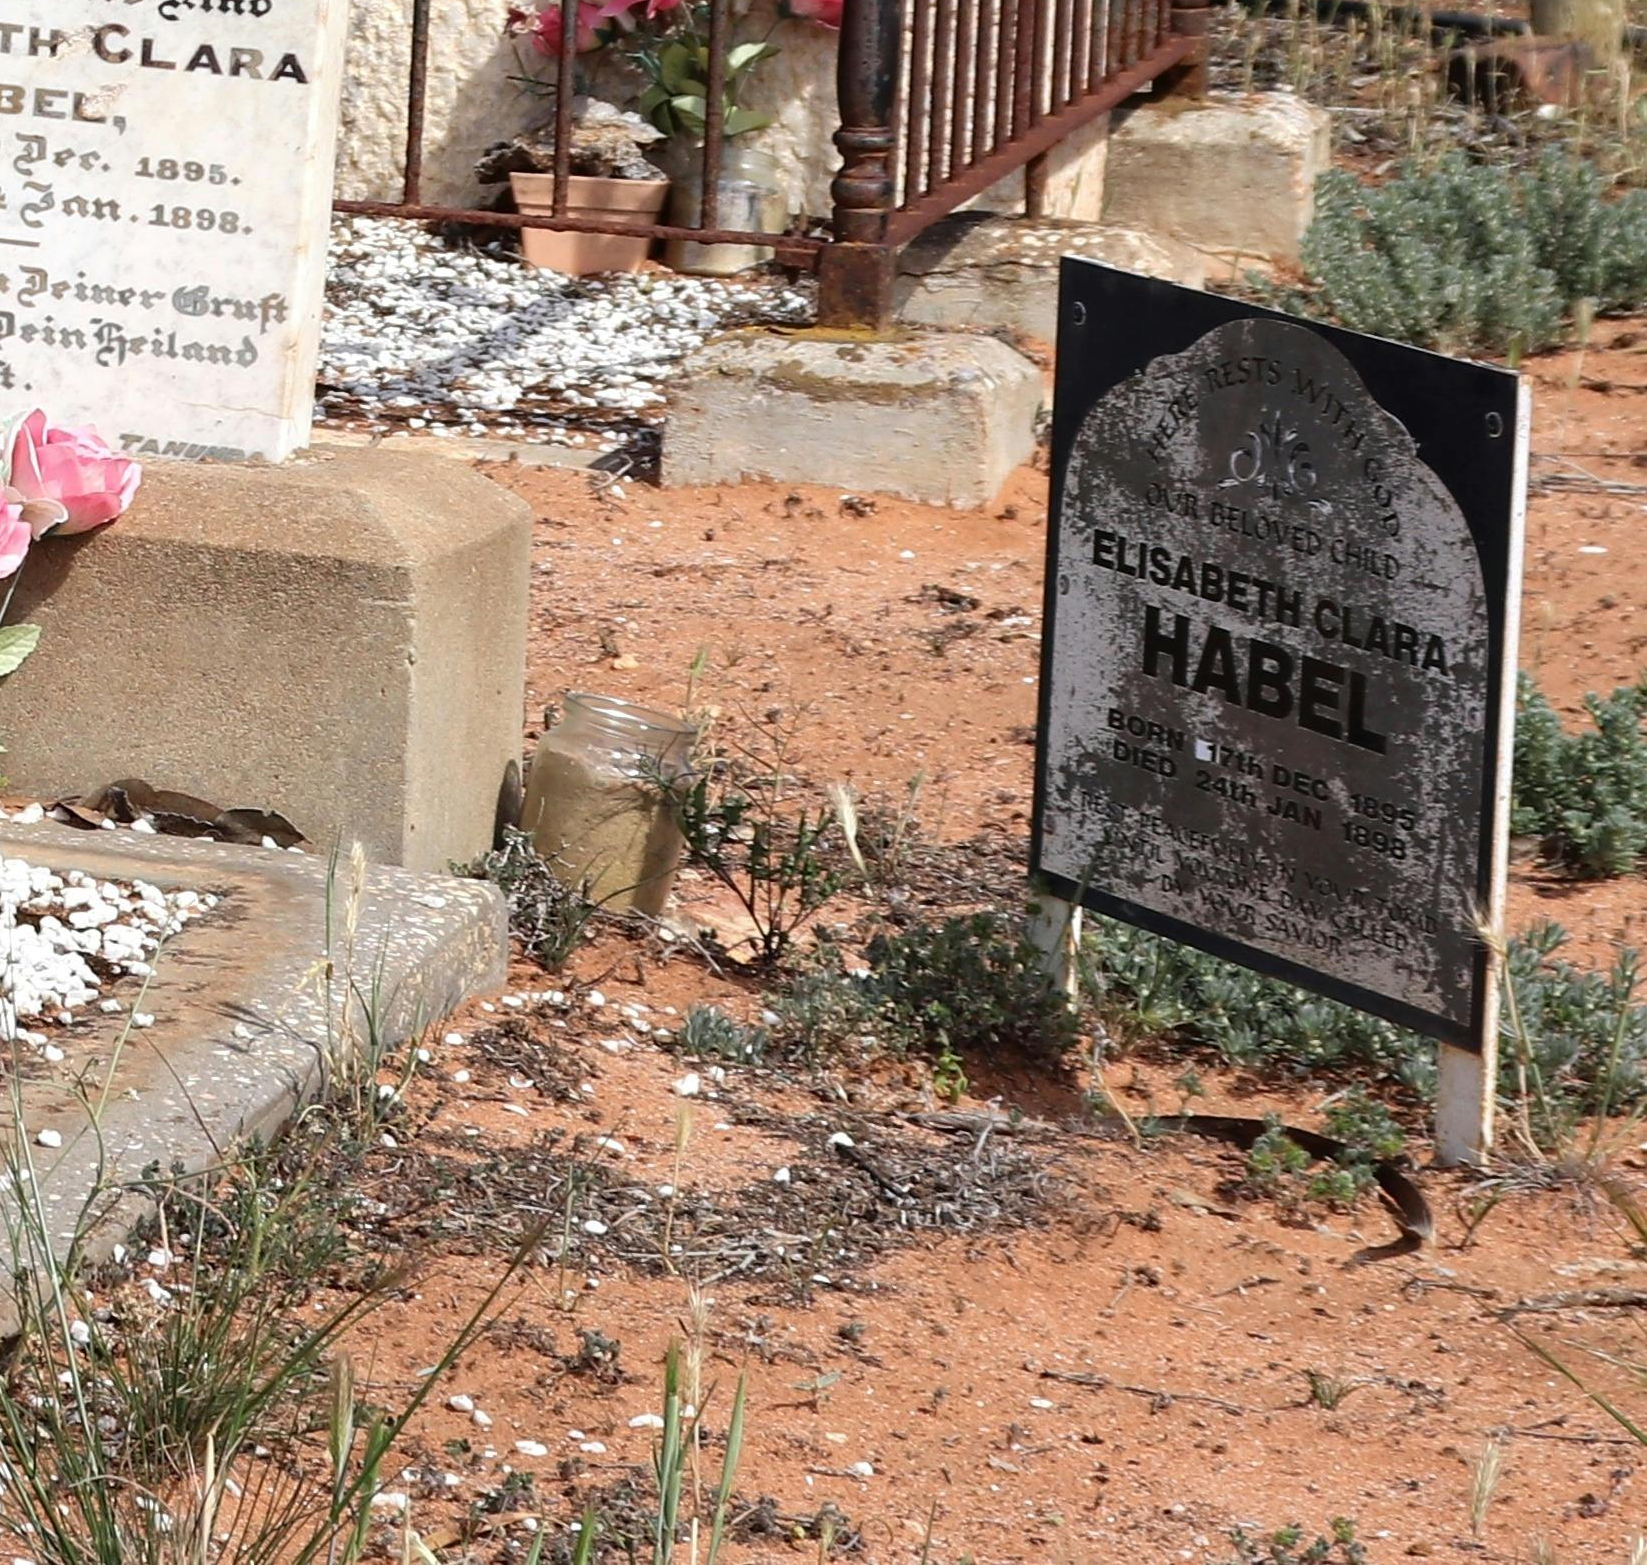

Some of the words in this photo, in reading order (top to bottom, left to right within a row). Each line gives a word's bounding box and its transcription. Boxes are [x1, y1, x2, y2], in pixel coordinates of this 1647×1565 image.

[92, 22, 310, 86] CLARA
[1205, 356, 1282, 393] RESTS
[1209, 500, 1323, 557] BELOVED
[1092, 528, 1303, 629] ELISABETH
[1313, 597, 1451, 677] CLARA
[1142, 603, 1388, 757] HABEL
[1107, 707, 1185, 752] BORN
[1271, 763, 1332, 803] DEC
[1351, 791, 1416, 832] 1895
[1113, 739, 1177, 778] DIED
[1196, 769, 1256, 809] 24th
[1266, 795, 1324, 832] JAN
[1342, 821, 1407, 861] 1898
